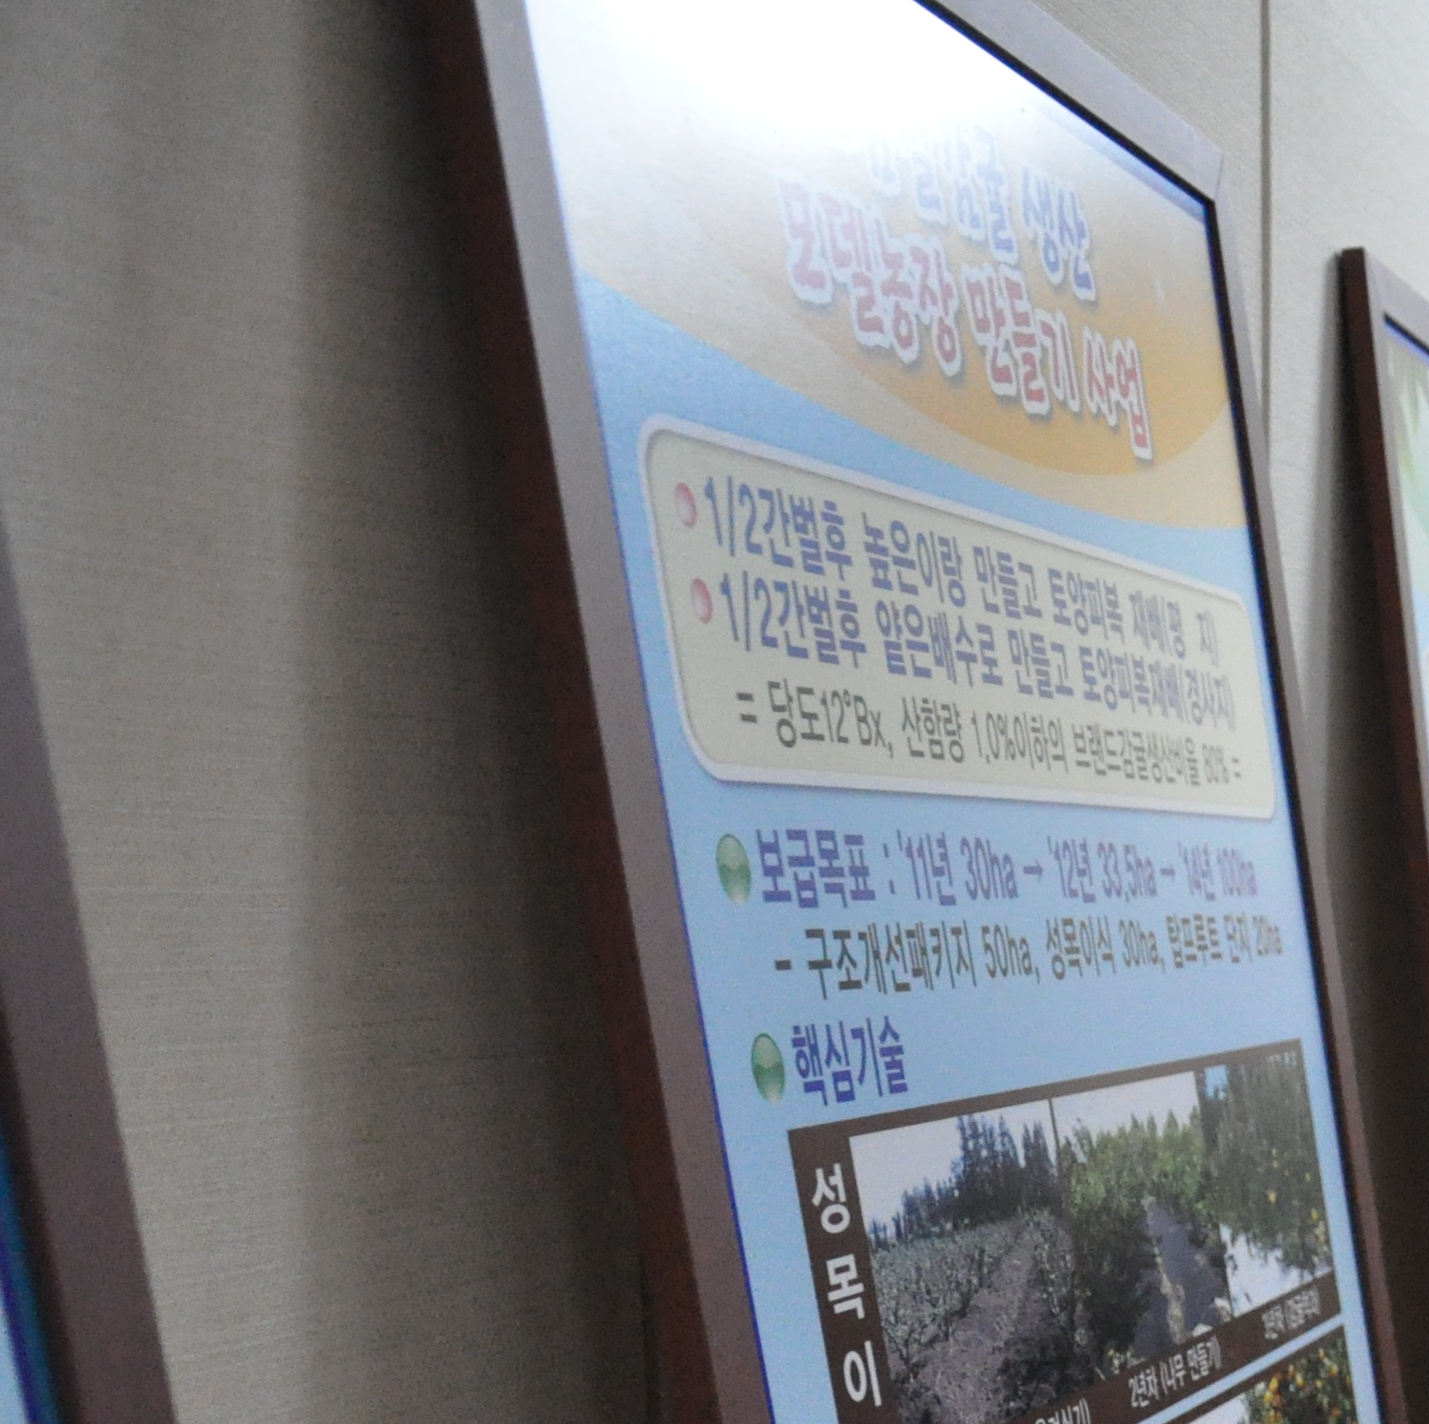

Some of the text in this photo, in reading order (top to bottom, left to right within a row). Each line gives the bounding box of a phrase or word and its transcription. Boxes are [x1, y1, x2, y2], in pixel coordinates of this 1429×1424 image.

[1020, 164, 1096, 300] 생산
[776, 170, 1152, 459] 모델농장 만들기 사업
[704, 476, 853, 581] 1/2간벌후
[972, 546, 1042, 620] 만들고
[720, 570, 867, 668] 1/2간벌후
[1007, 628, 1074, 698] 만들고
[901, 696, 964, 763] 산함량
[756, 829, 875, 909] 보급목표
[960, 837, 1018, 901] 30ha
[805, 920, 977, 1000] 구조개선패키지
[1046, 916, 1116, 980] 성목이식
[792, 1015, 908, 1106] 핵심기술
